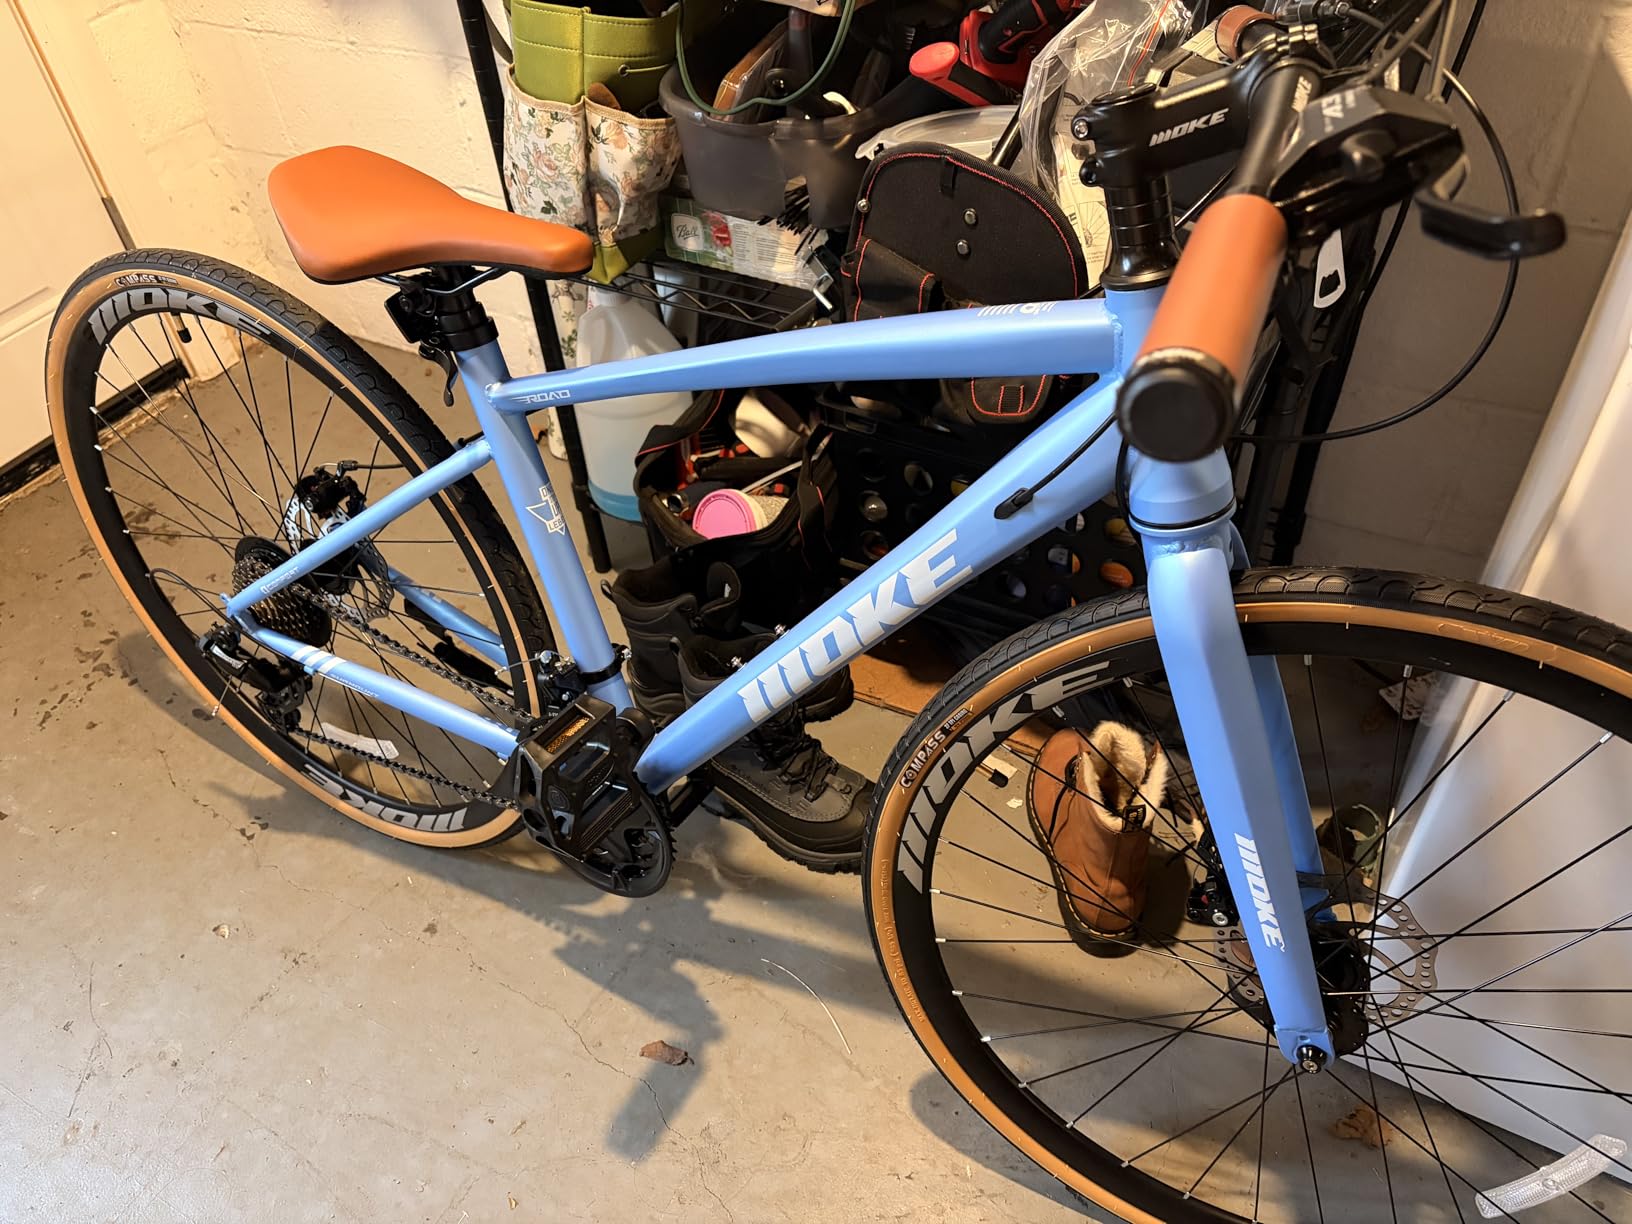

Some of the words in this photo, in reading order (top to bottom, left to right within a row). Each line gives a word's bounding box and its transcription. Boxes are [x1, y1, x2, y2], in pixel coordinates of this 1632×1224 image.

[1148, 107, 1230, 148] MOKE
[675, 223, 700, 241] Ball
[114, 273, 158, 287] COMPASS
[87, 287, 273, 346] MOKE
[517, 389, 571, 404] ROAD
[736, 527, 974, 724] MOKE
[897, 660, 1115, 895] MOKE
[899, 730, 946, 789] COMPASS
[300, 763, 469, 832] MOKE
[1233, 832, 1286, 953] MOKE
